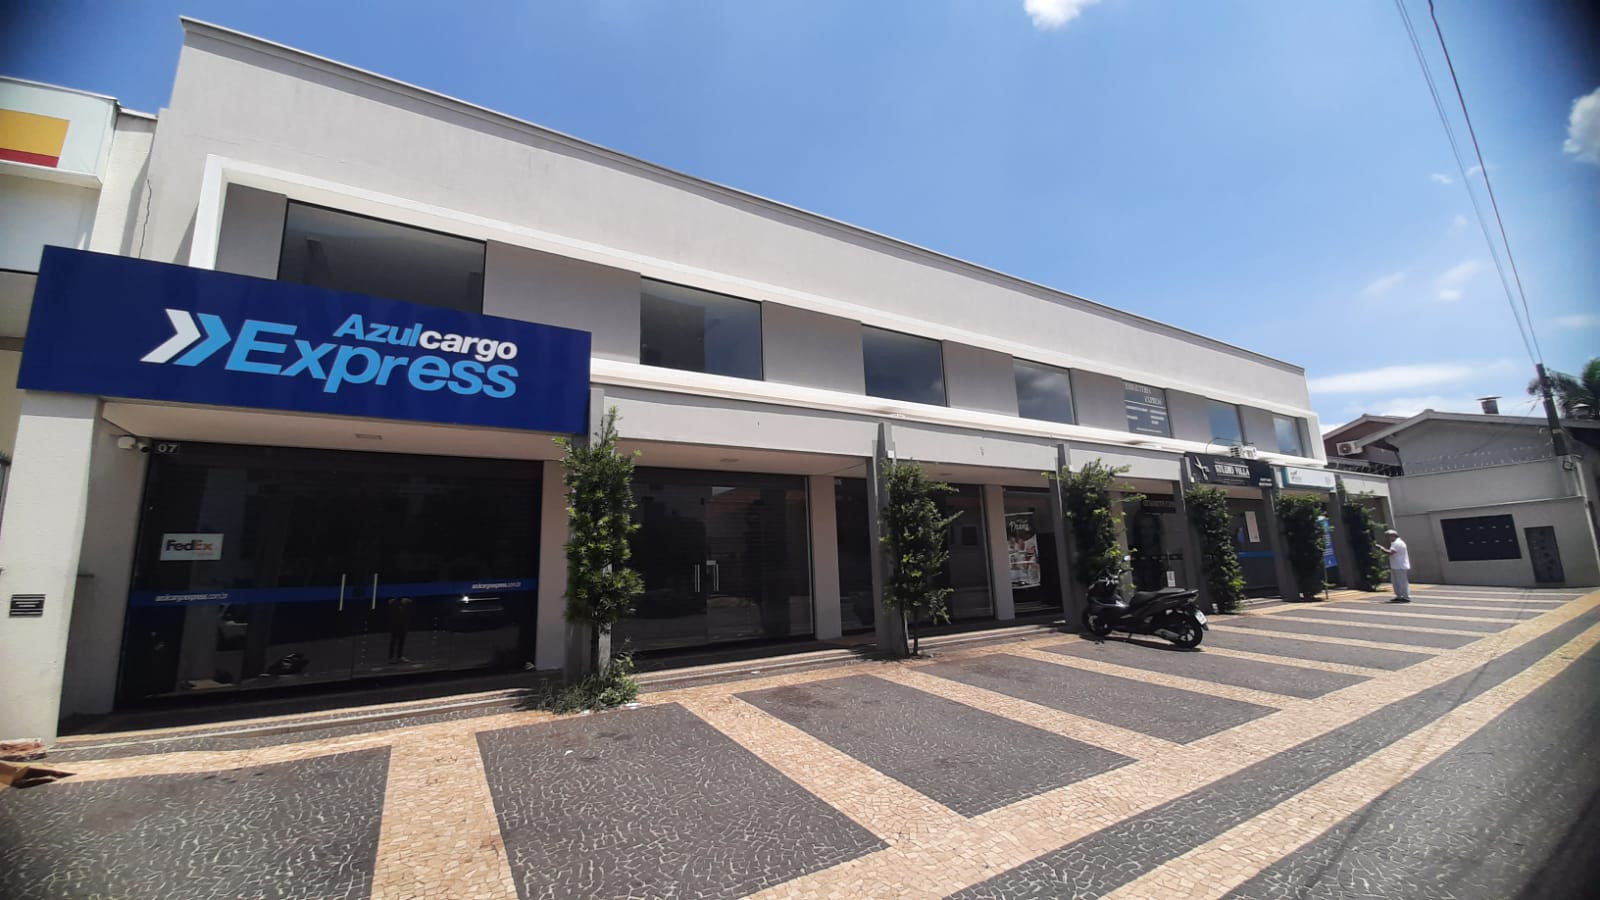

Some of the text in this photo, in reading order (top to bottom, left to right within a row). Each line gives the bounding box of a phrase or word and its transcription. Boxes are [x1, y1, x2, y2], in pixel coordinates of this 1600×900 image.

[224, 319, 519, 398] Express
[158, 444, 177, 453] 07
[166, 539, 213, 551] FedEx
